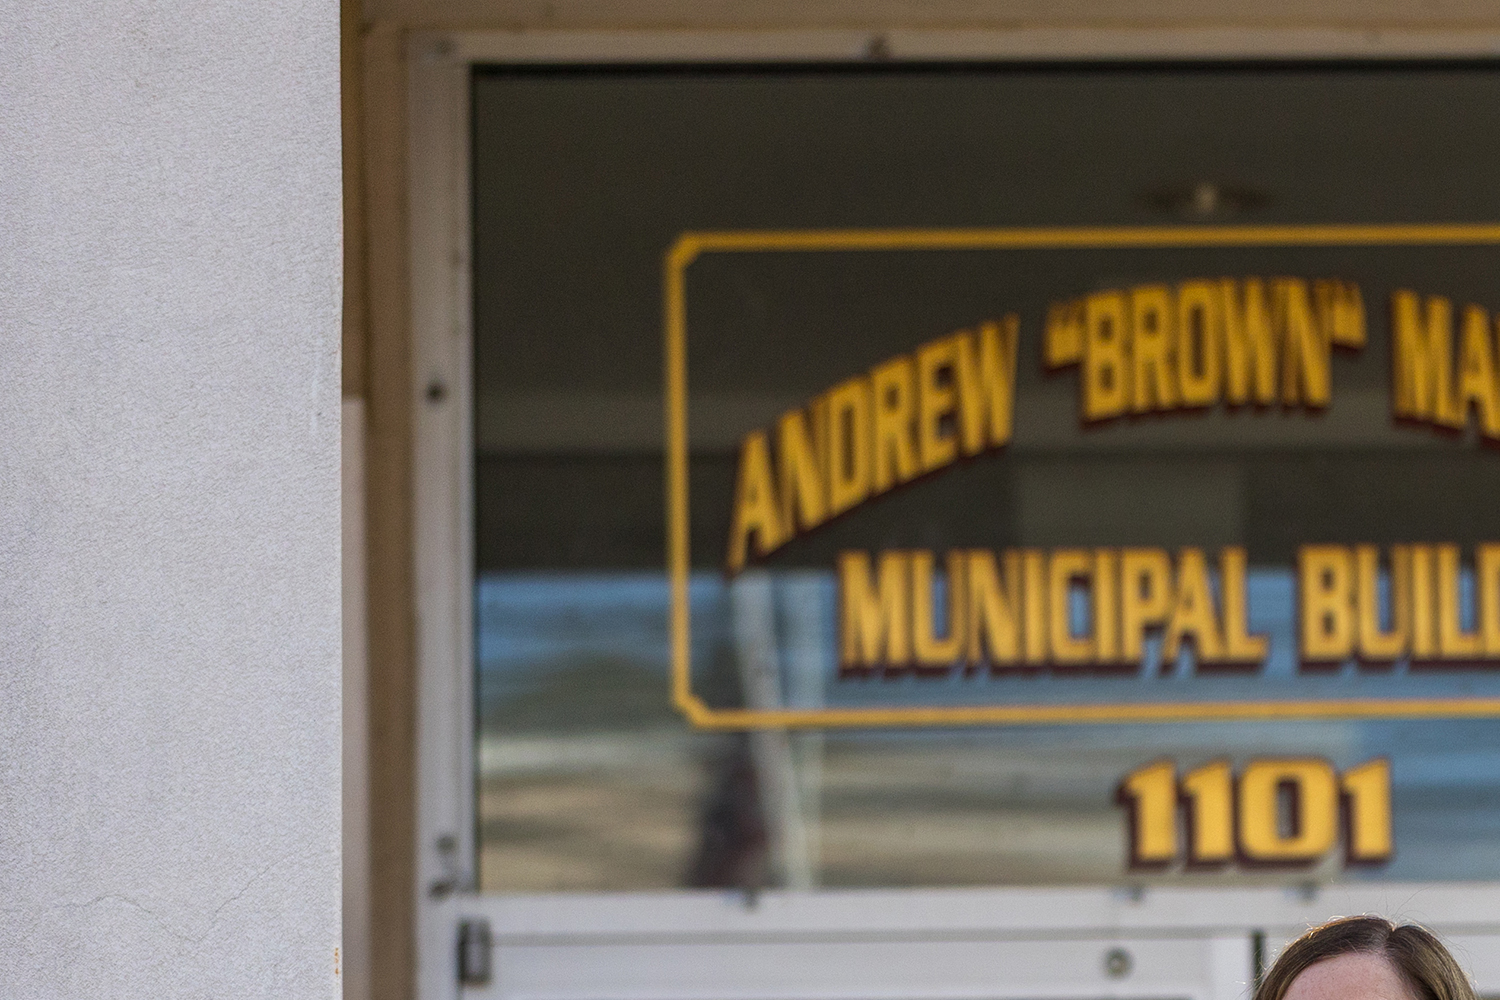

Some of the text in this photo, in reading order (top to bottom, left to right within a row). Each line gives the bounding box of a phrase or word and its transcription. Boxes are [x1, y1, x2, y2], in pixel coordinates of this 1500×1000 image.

[726, 312, 1021, 568] ANDREW
[837, 547, 1268, 672] MUNICIPAL
[1117, 756, 1394, 868] 1101
